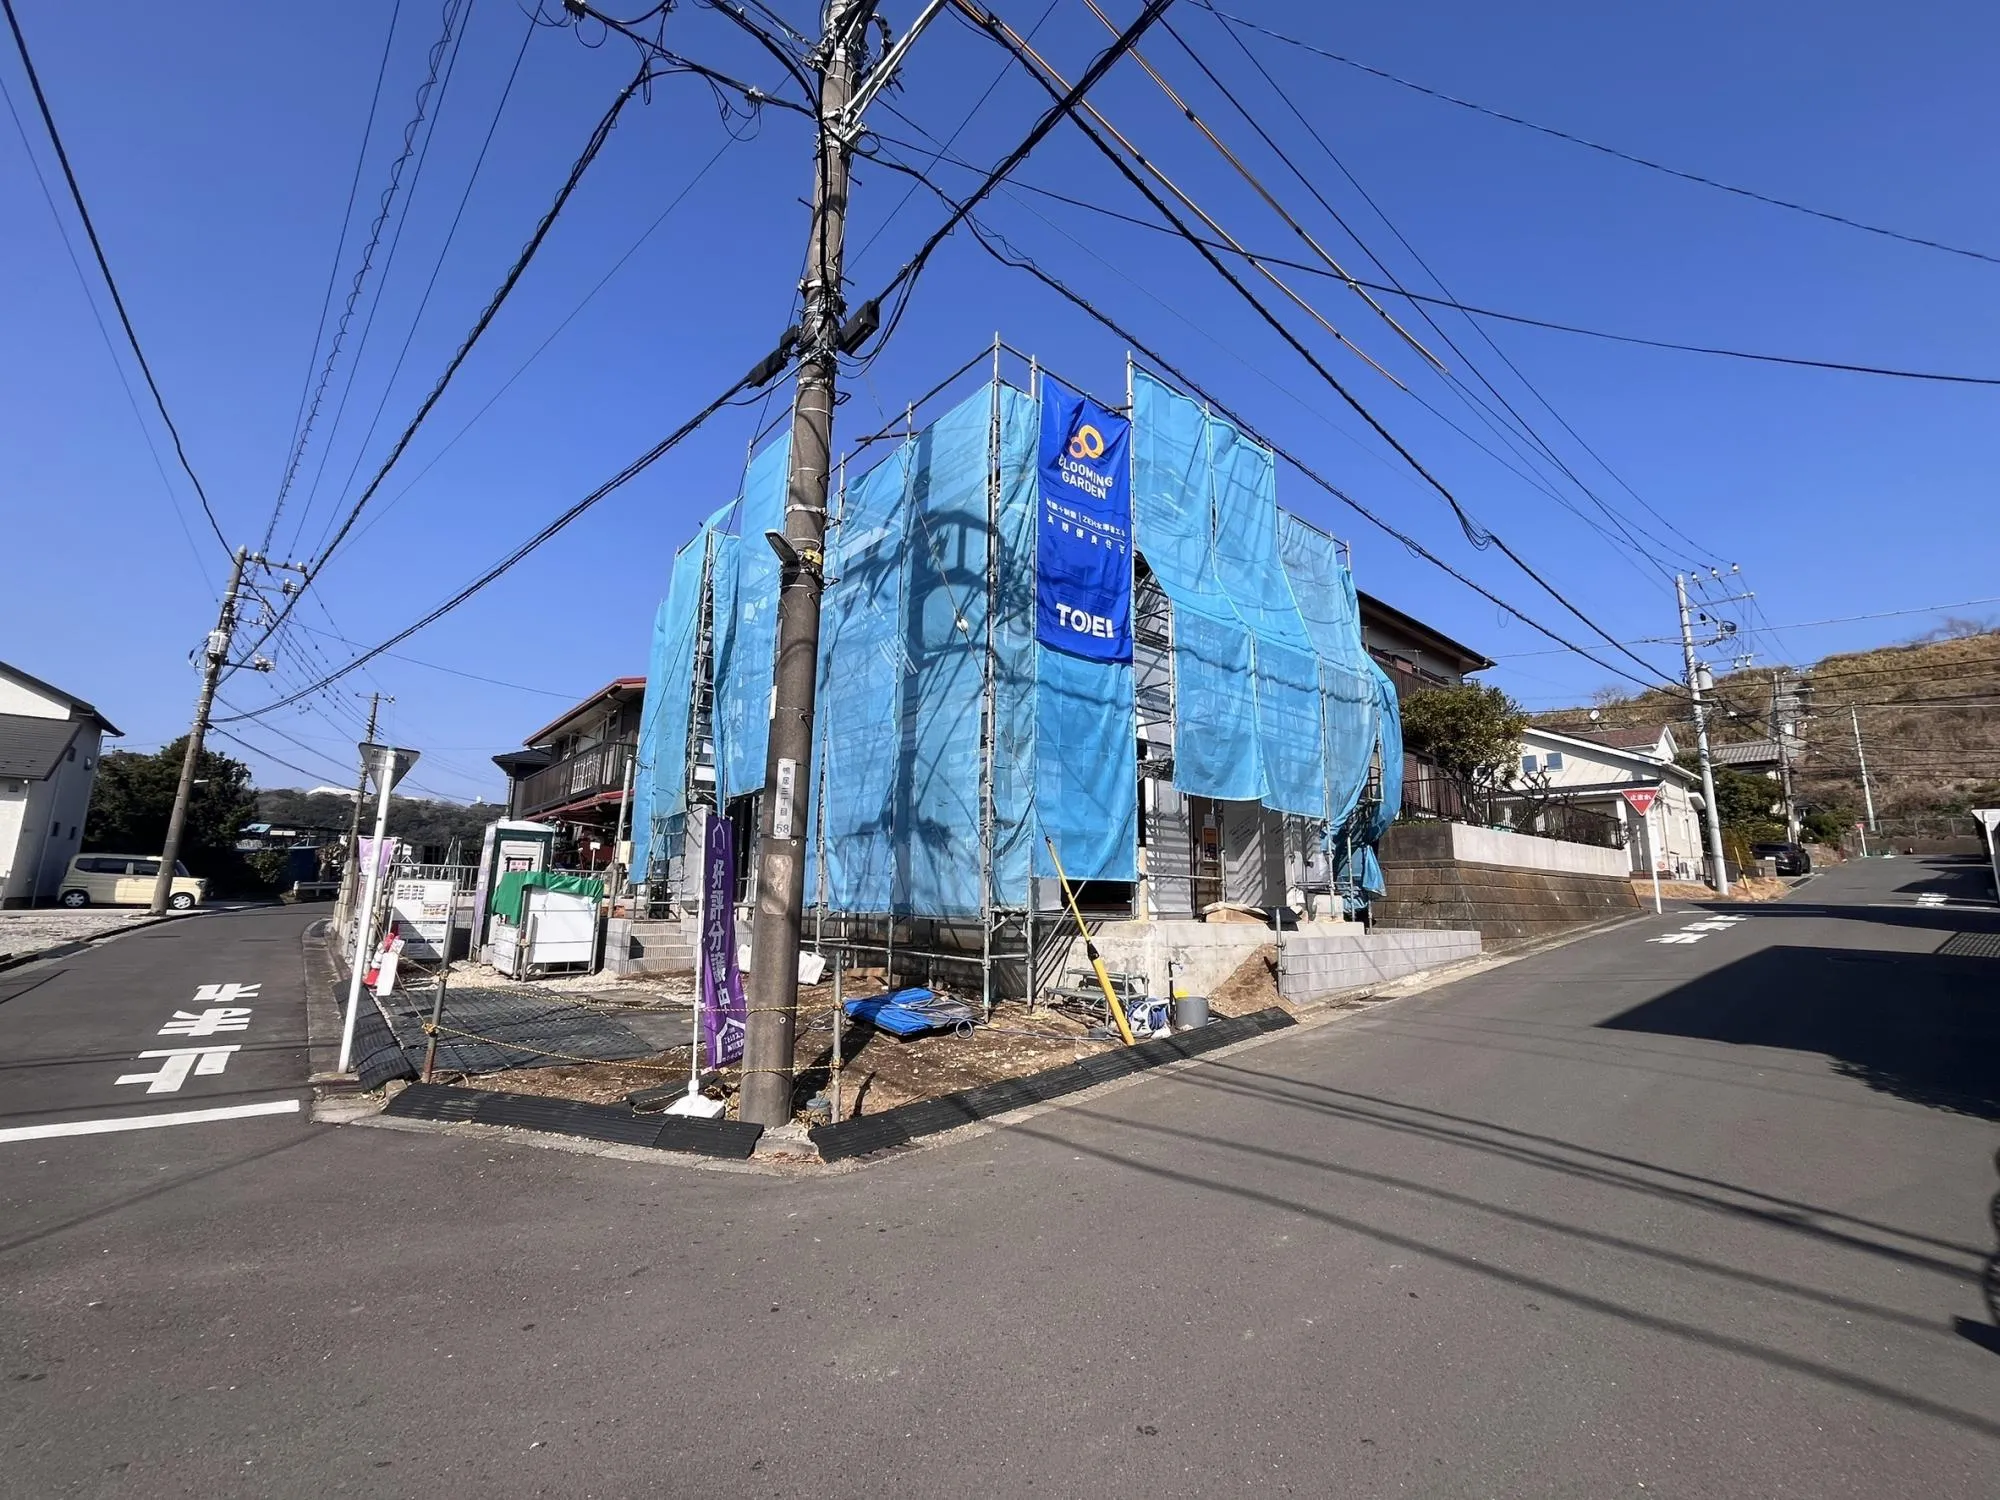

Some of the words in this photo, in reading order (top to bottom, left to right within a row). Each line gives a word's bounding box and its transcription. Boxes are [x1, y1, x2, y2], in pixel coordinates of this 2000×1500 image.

[1058, 454, 1113, 487] BLOOMING
[1062, 471, 1107, 500] GARDEN
[1055, 603, 1114, 638] TOEI
[776, 823, 790, 834] 58
[708, 859, 731, 1014] 好評分譲中
[113, 983, 263, 1095] 止まれ
